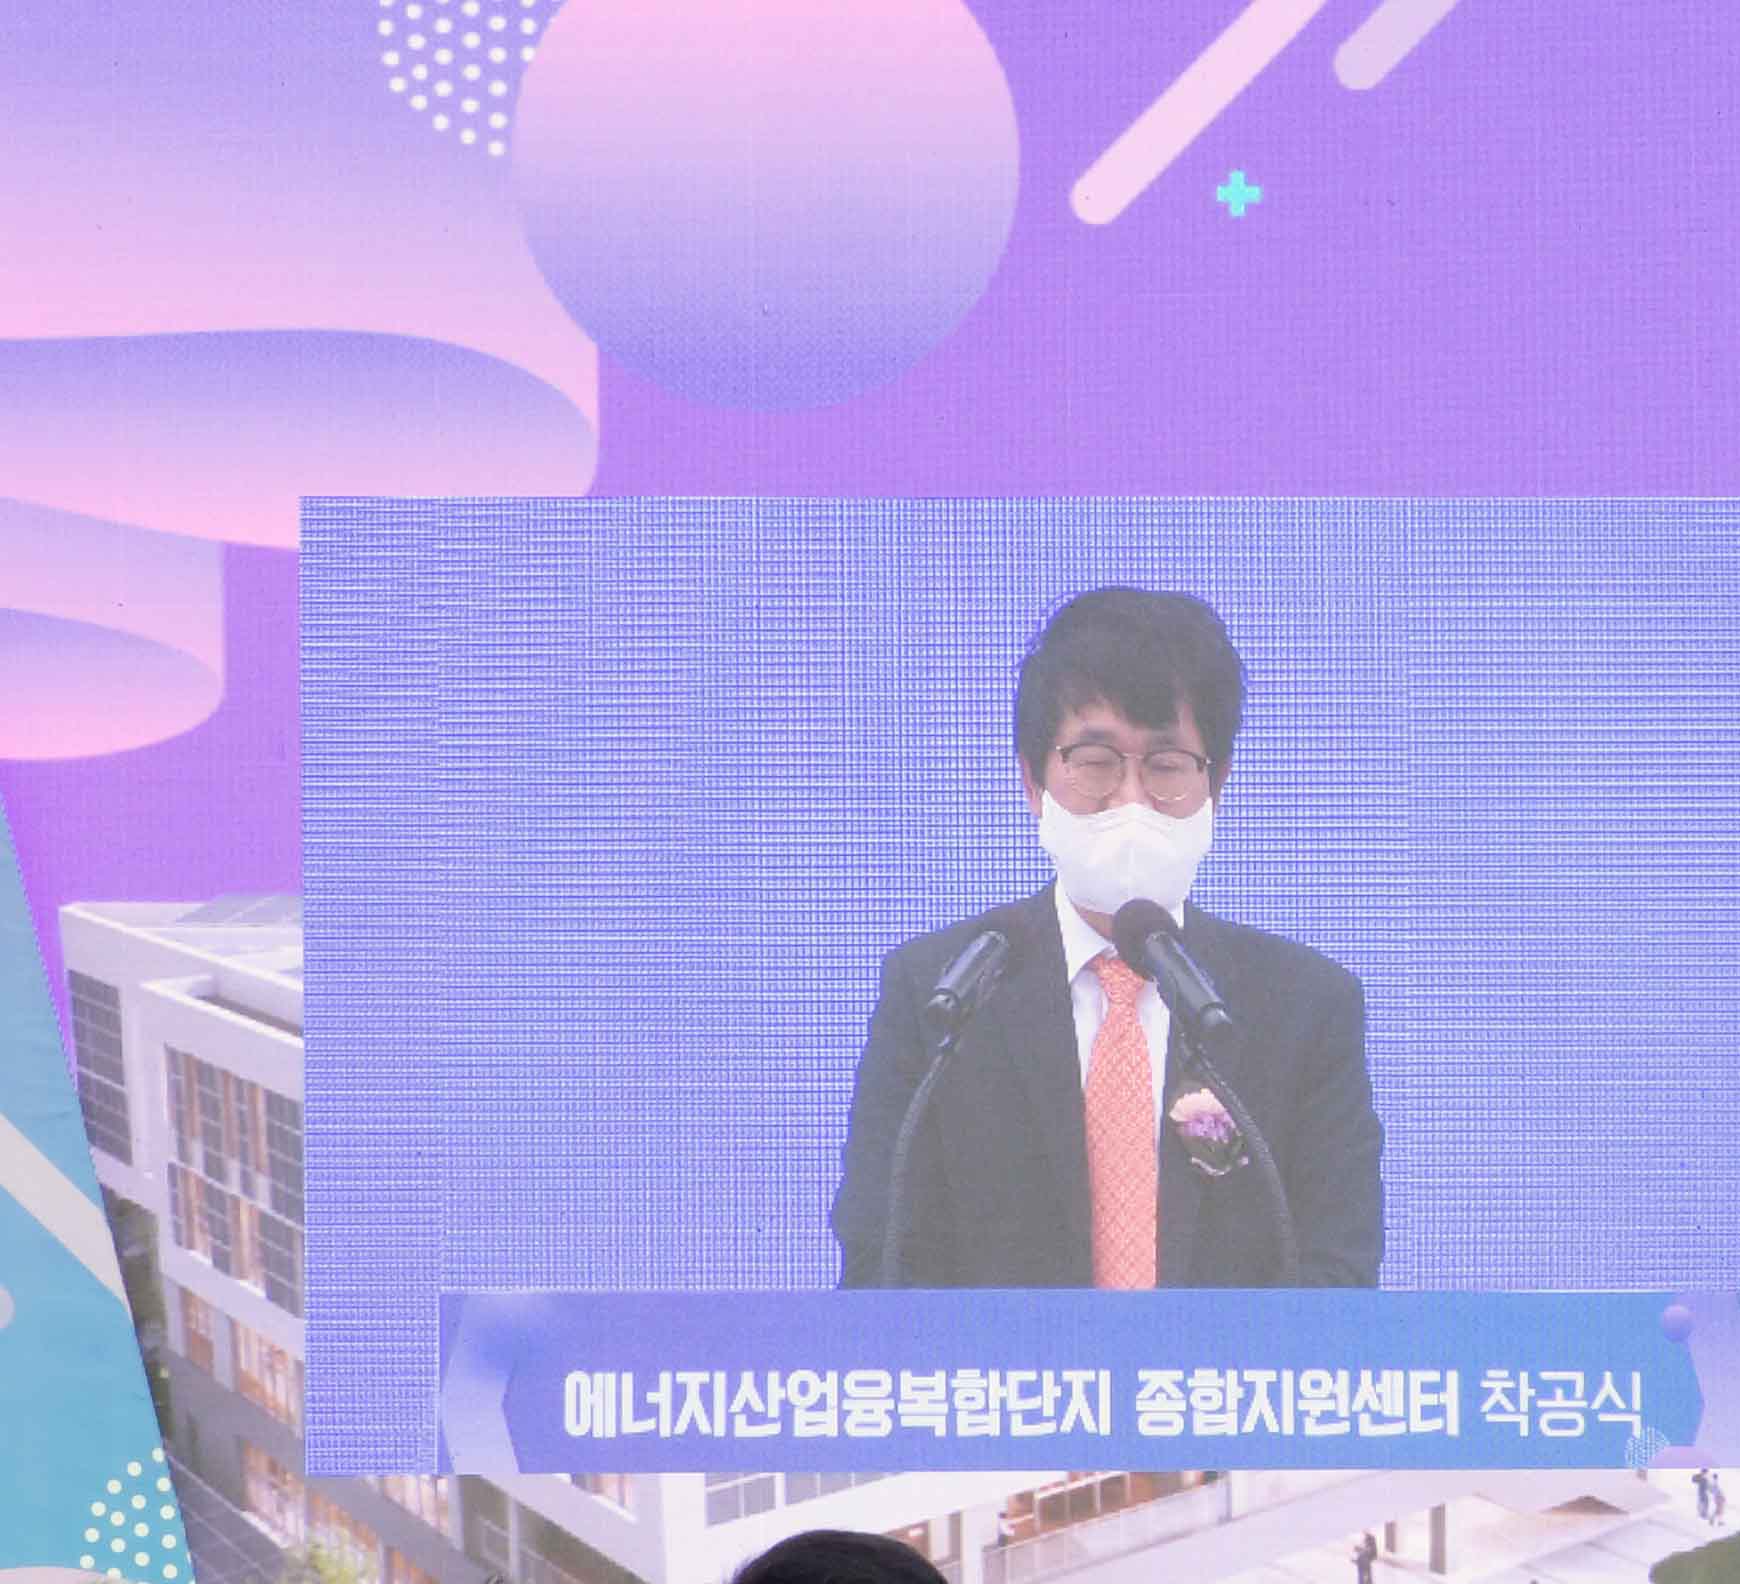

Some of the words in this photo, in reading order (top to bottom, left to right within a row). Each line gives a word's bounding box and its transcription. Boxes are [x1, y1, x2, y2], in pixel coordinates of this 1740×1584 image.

[565, 1369, 1111, 1438] 에너지산업융복합단지
[1135, 1369, 1459, 1436] 종합지원센터
[1481, 1370, 1642, 1438] 착공식
